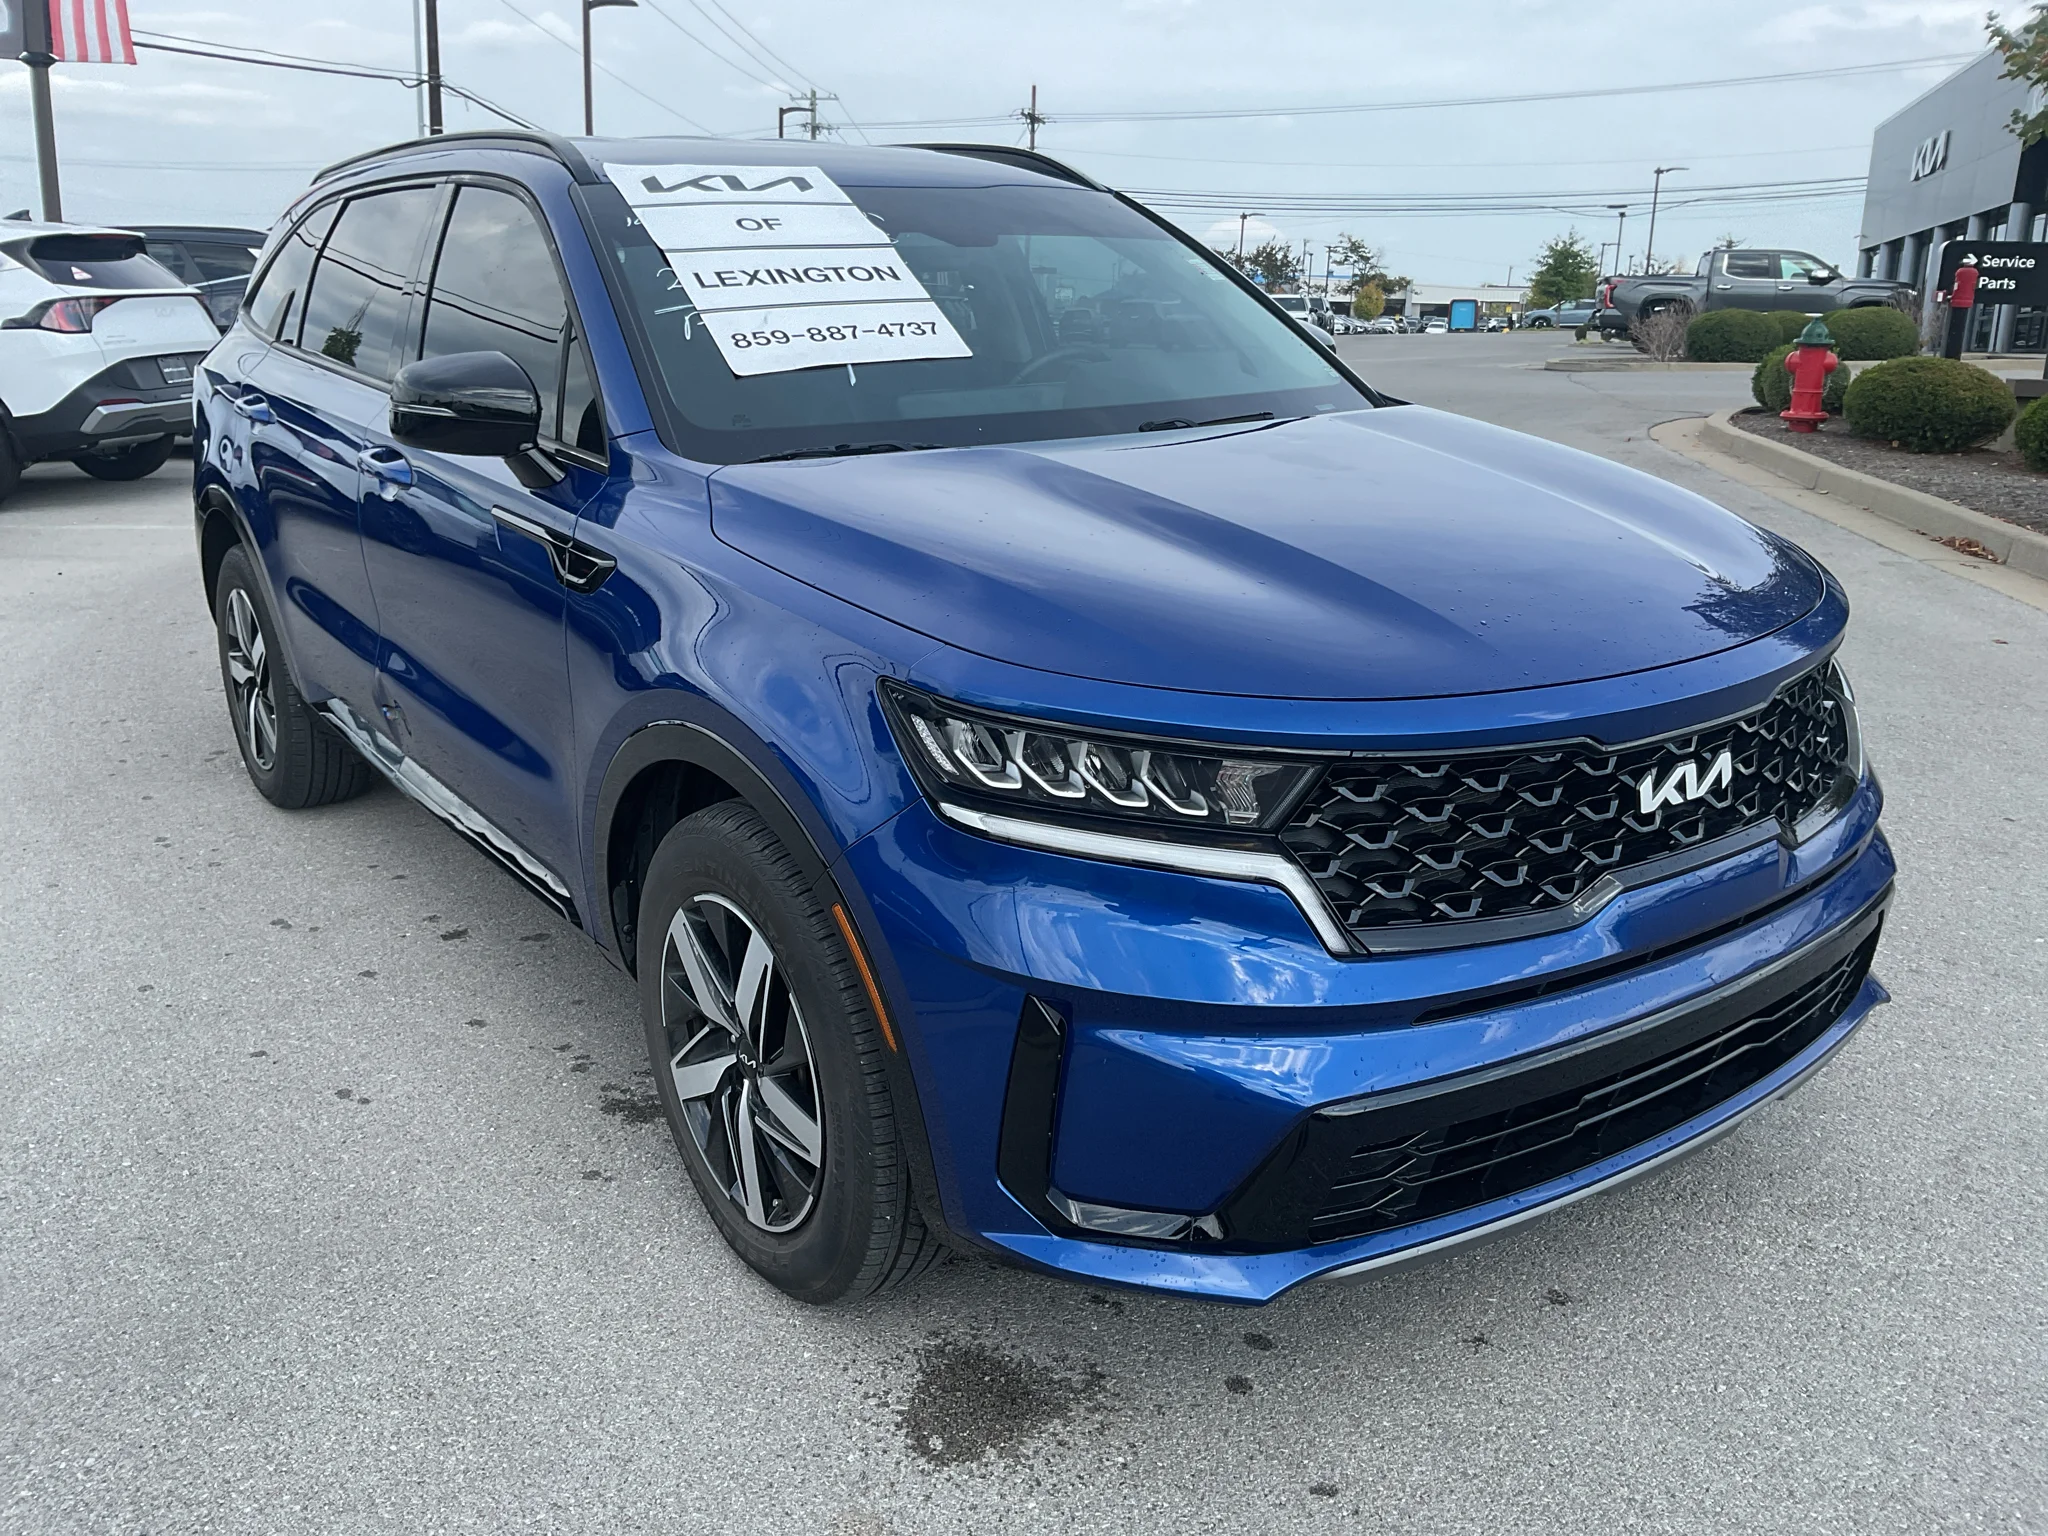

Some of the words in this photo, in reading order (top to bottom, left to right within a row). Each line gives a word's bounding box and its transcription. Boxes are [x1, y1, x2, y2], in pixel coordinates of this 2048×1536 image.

[1910, 130, 1949, 182] KIA
[641, 174, 814, 193] KIA
[735, 217, 784, 232] OF
[1982, 254, 2036, 268] Service
[692, 265, 901, 289] LEXINGTON
[1978, 276, 2016, 290] Parts
[731, 321, 937, 349] 859-887-4737
[1637, 749, 1732, 814] KIA
